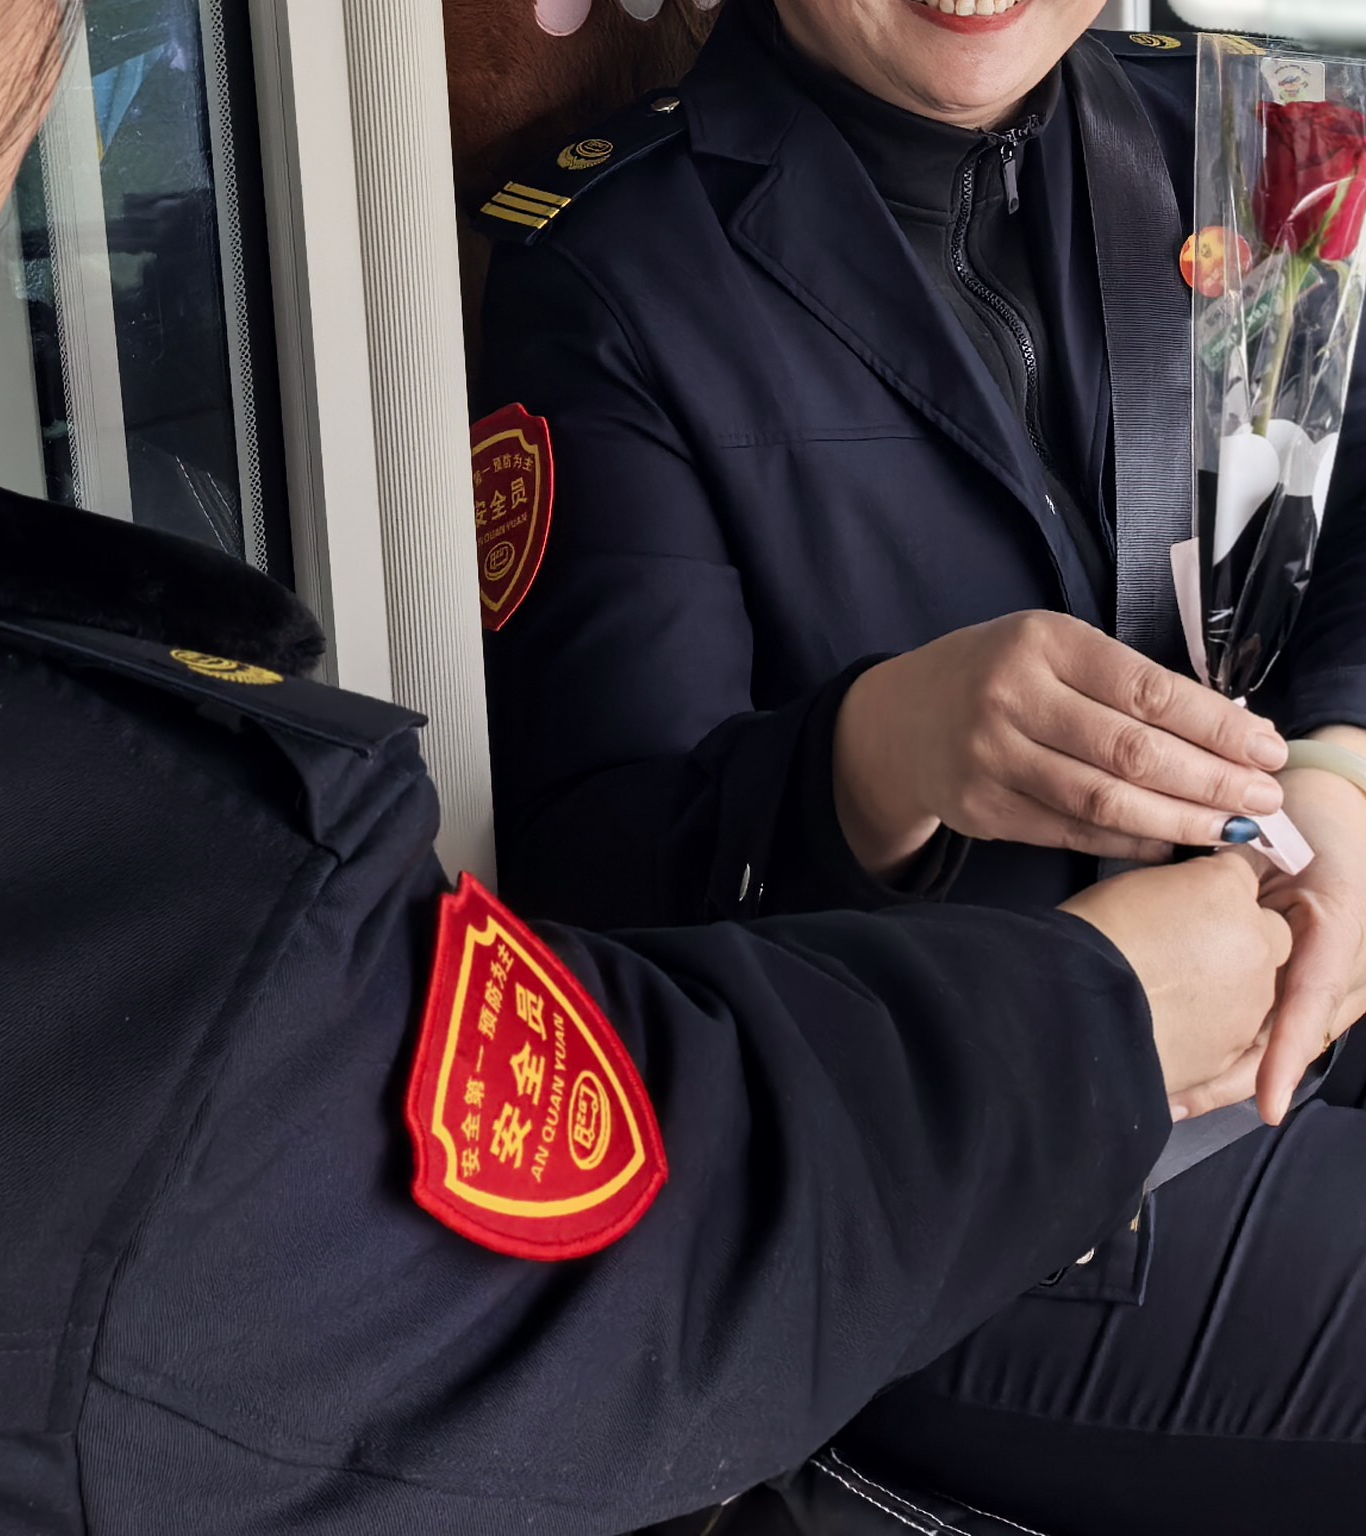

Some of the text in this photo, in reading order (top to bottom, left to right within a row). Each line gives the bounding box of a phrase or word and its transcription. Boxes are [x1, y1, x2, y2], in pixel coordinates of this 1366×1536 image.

[489, 981, 548, 1170] 安全员
[530, 1012, 566, 1183] AN QUAN YUAN
